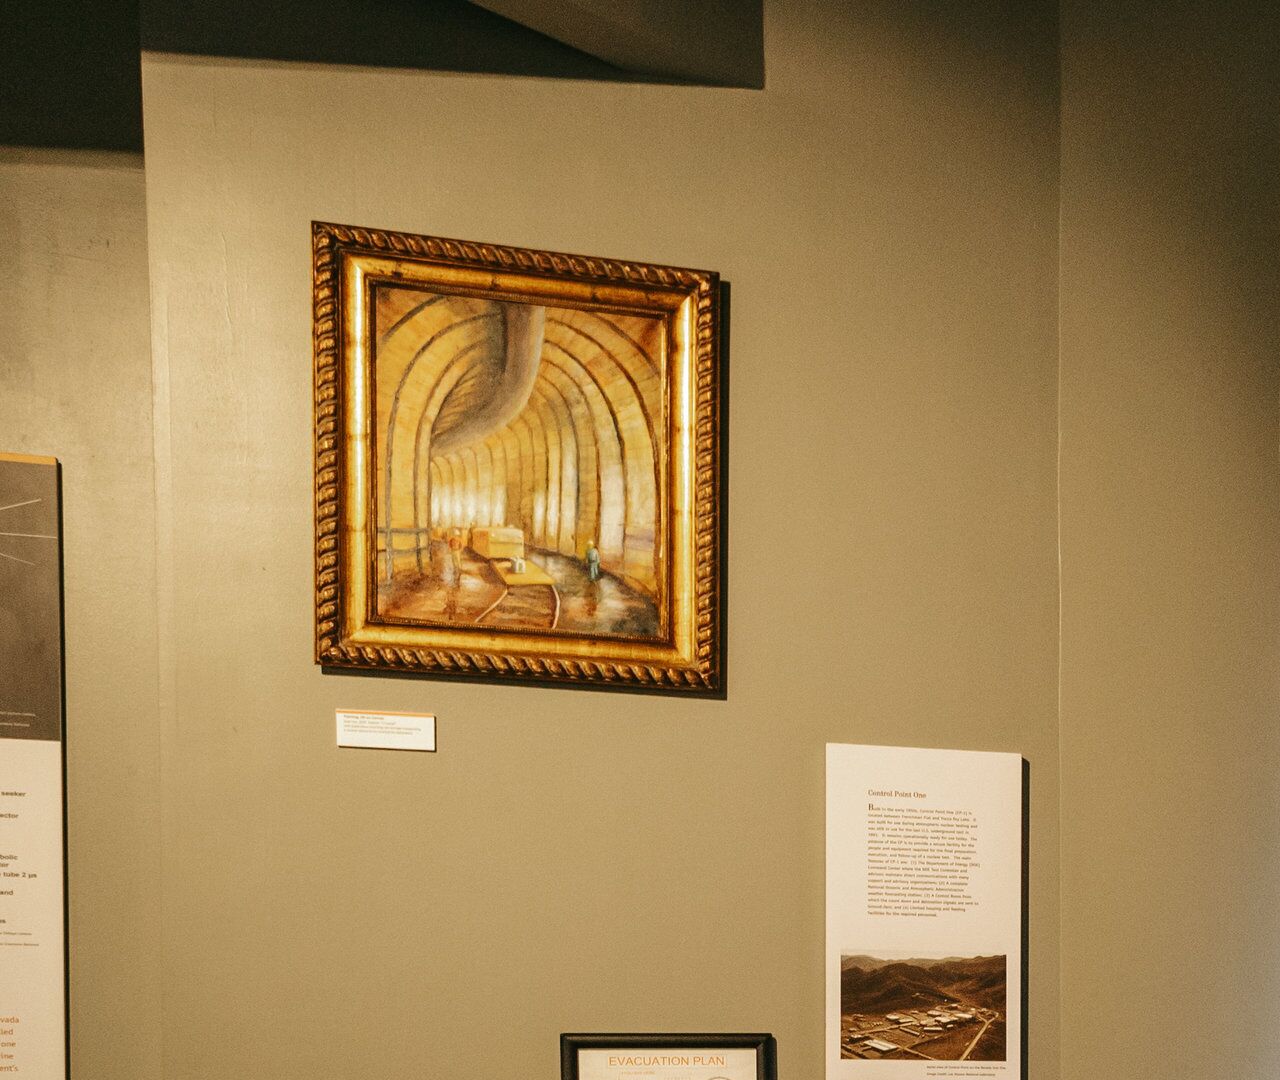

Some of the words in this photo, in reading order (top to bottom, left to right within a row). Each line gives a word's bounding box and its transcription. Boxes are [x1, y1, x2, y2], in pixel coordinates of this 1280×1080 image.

[868, 789, 893, 797] Control
[894, 790, 912, 798] Point
[913, 791, 927, 799] One
[608, 1056, 689, 1066] EVACUATION
[693, 1056, 725, 1066] PLAN
